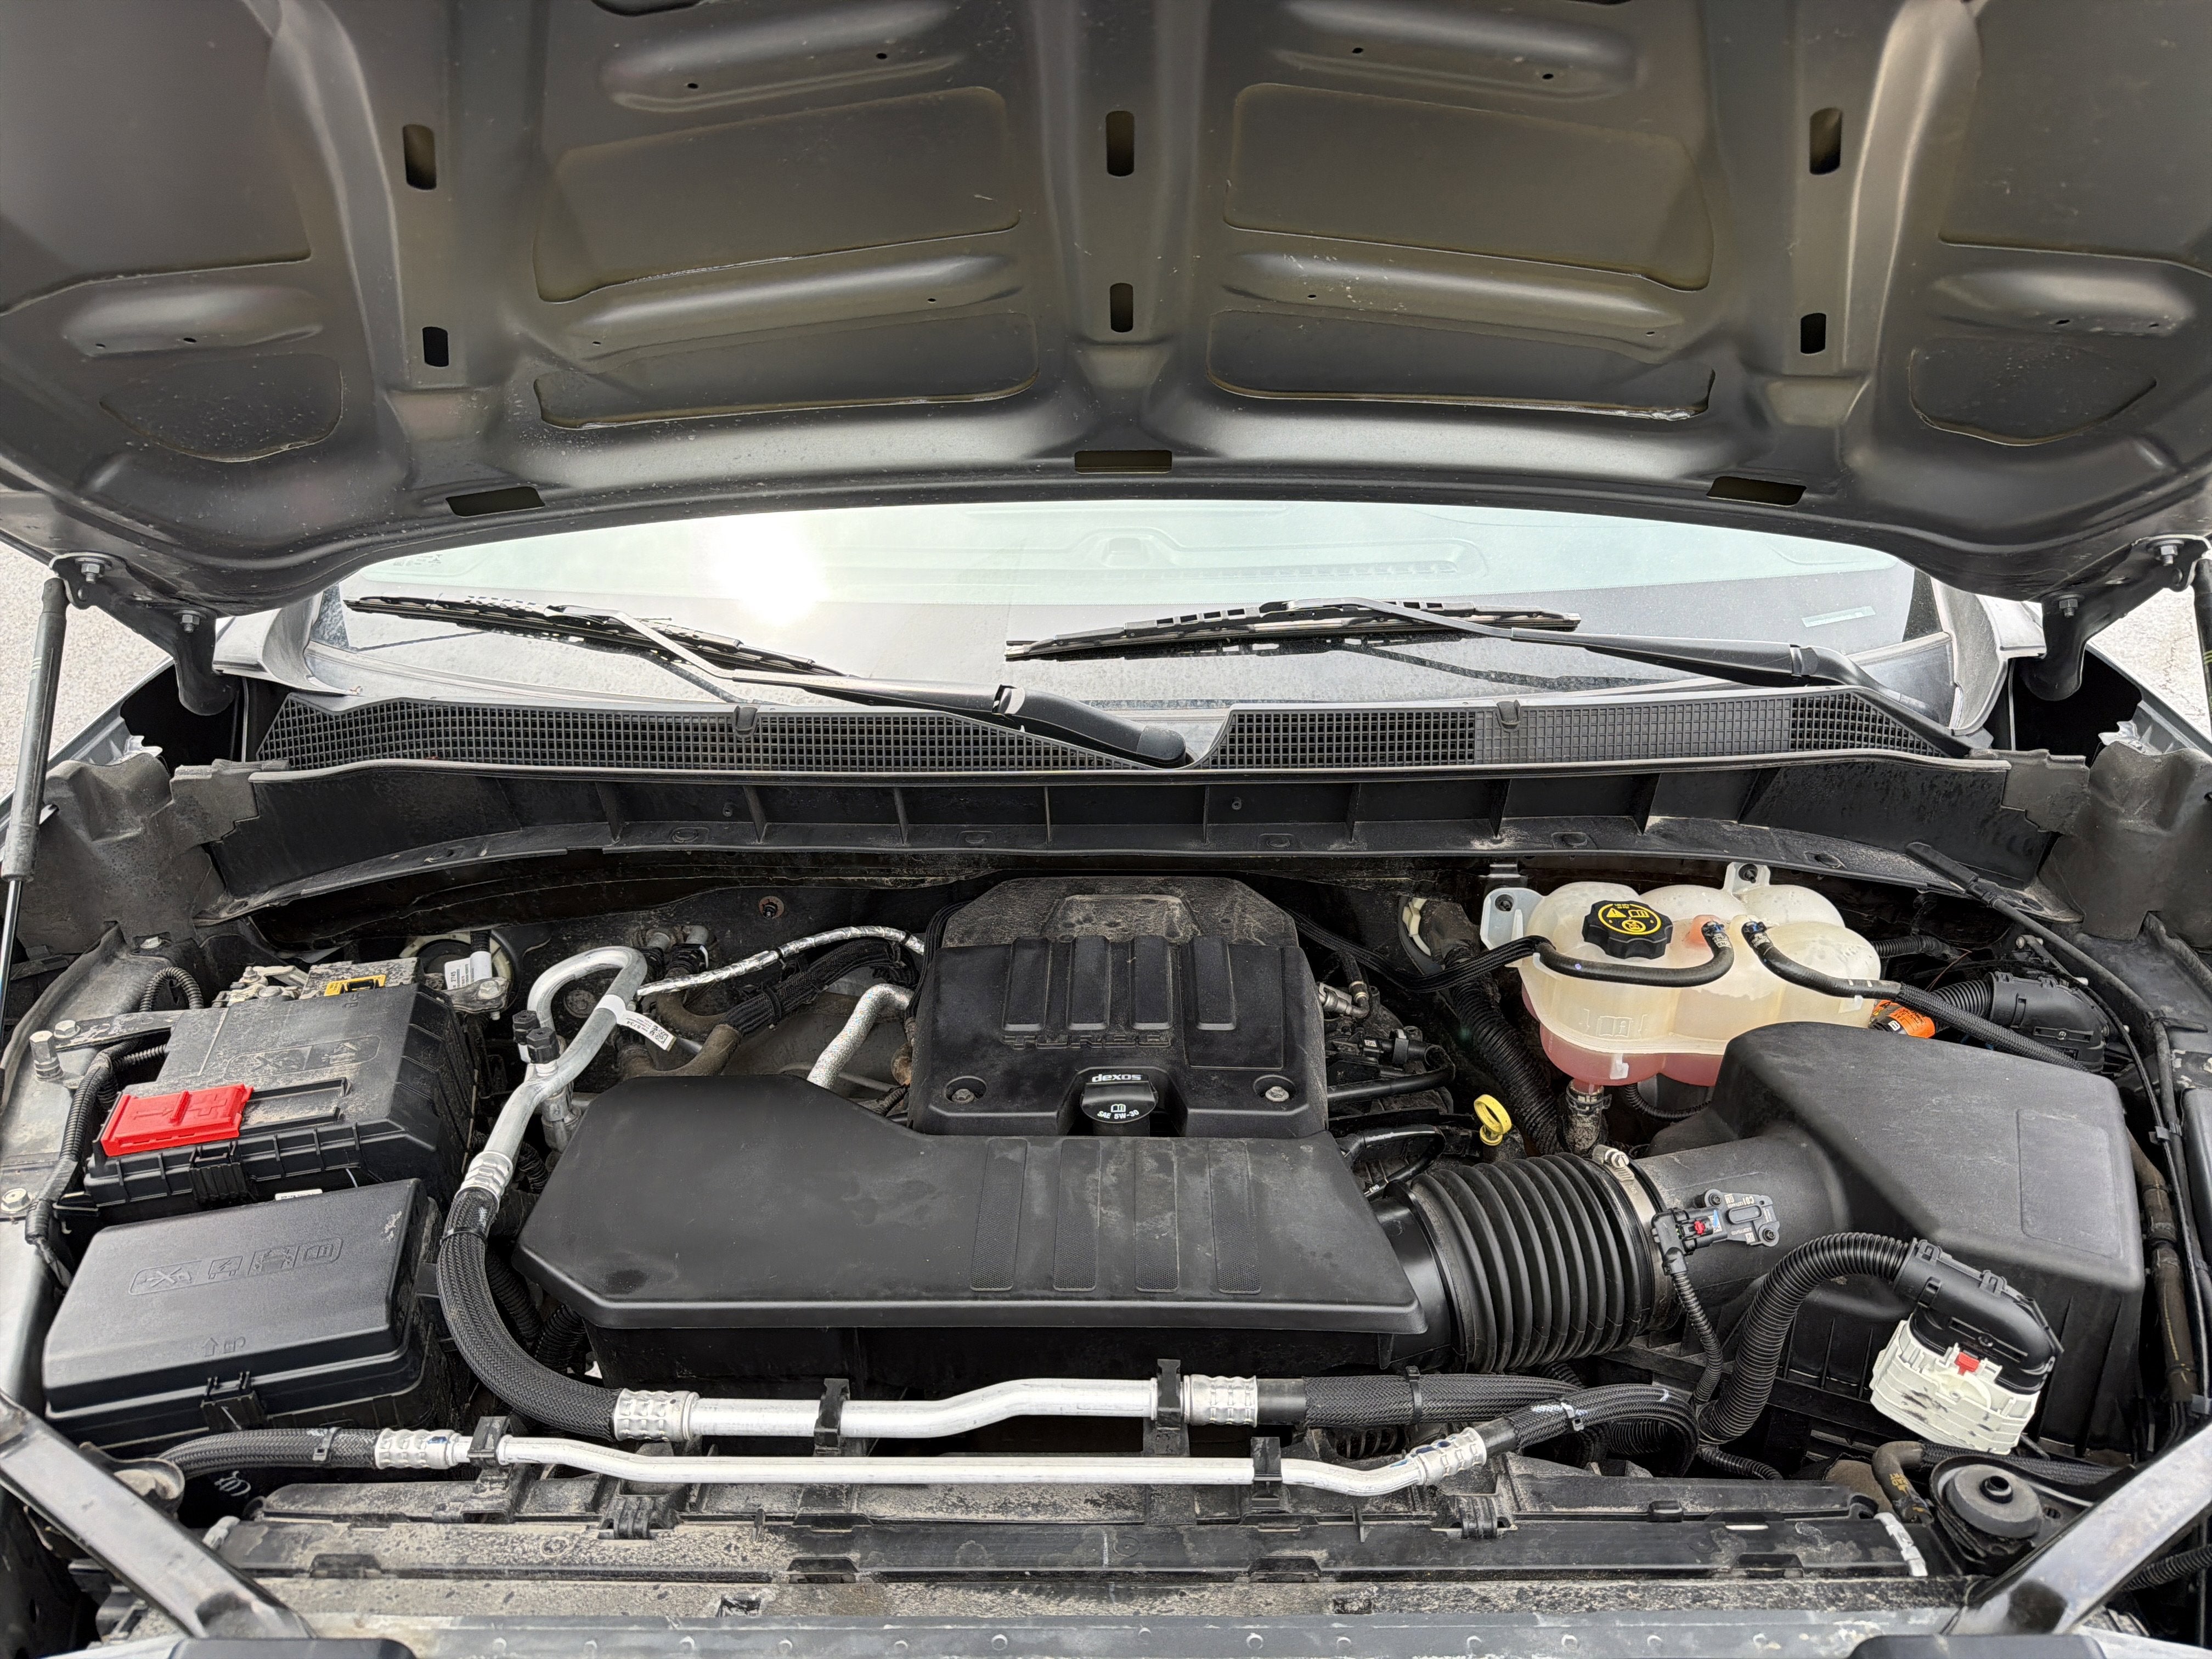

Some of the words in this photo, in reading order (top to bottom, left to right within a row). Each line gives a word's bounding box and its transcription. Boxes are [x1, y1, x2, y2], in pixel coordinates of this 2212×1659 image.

[1092, 1074, 1141, 1082] dexos
[1097, 1110, 1111, 1119] SAE
[1114, 1109, 1139, 1120] 5W-30
